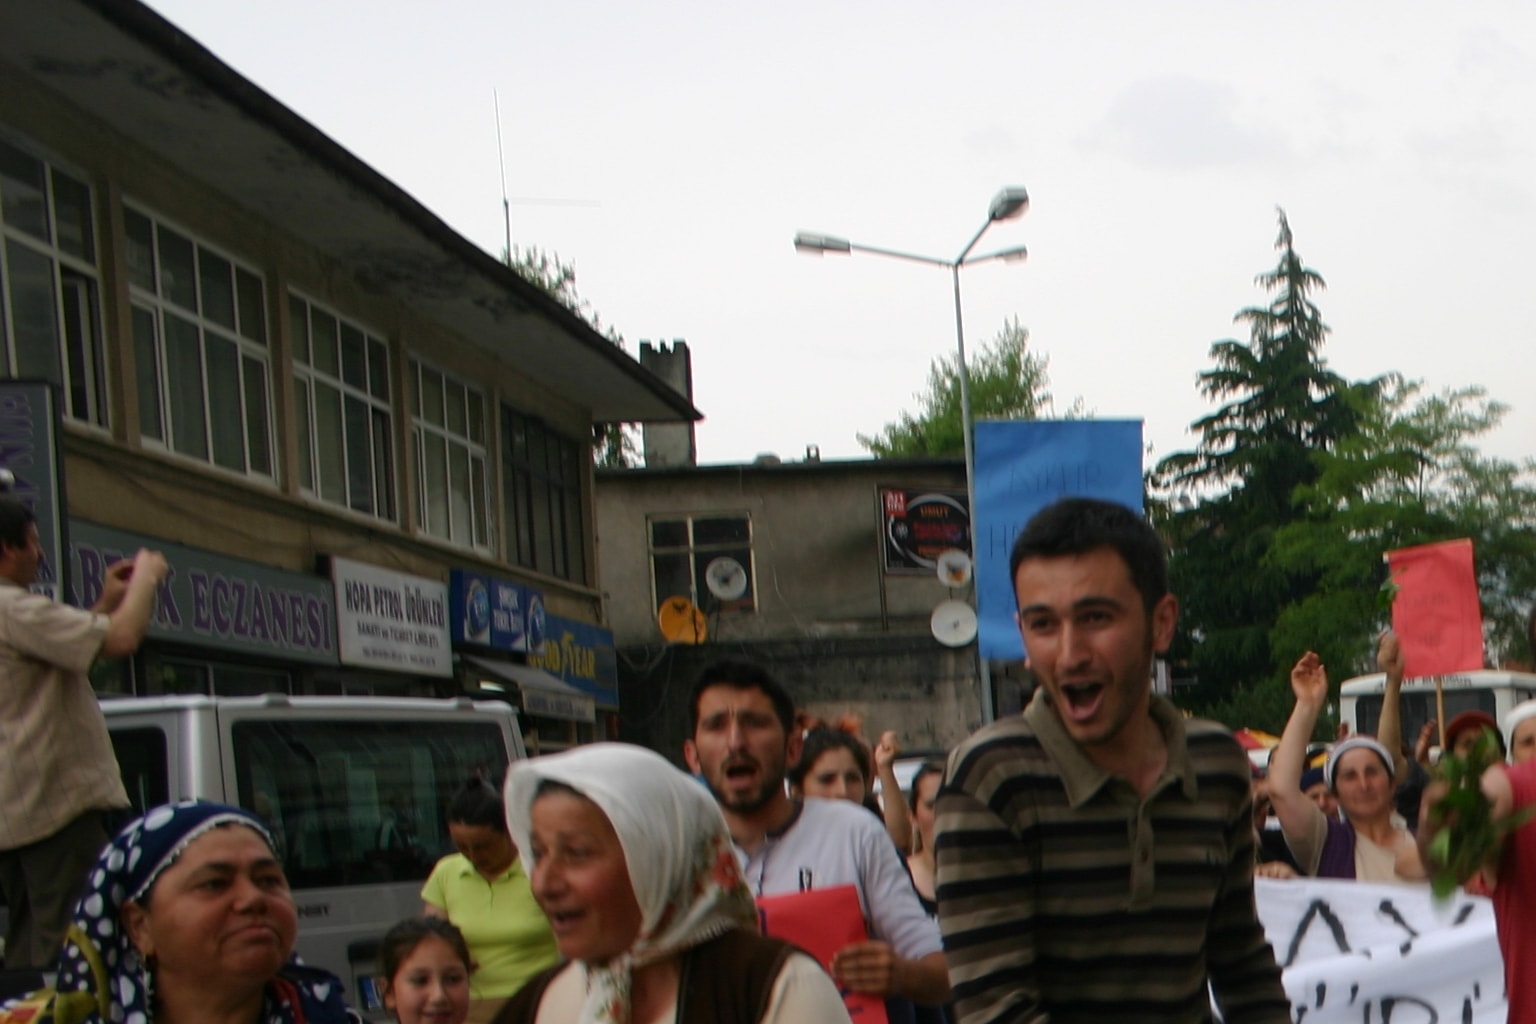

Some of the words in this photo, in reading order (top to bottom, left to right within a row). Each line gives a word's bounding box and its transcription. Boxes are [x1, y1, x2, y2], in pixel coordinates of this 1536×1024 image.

[188, 569, 333, 651] ECZANESİ
[344, 579, 373, 616] HOPA
[373, 585, 404, 623] PETROL
